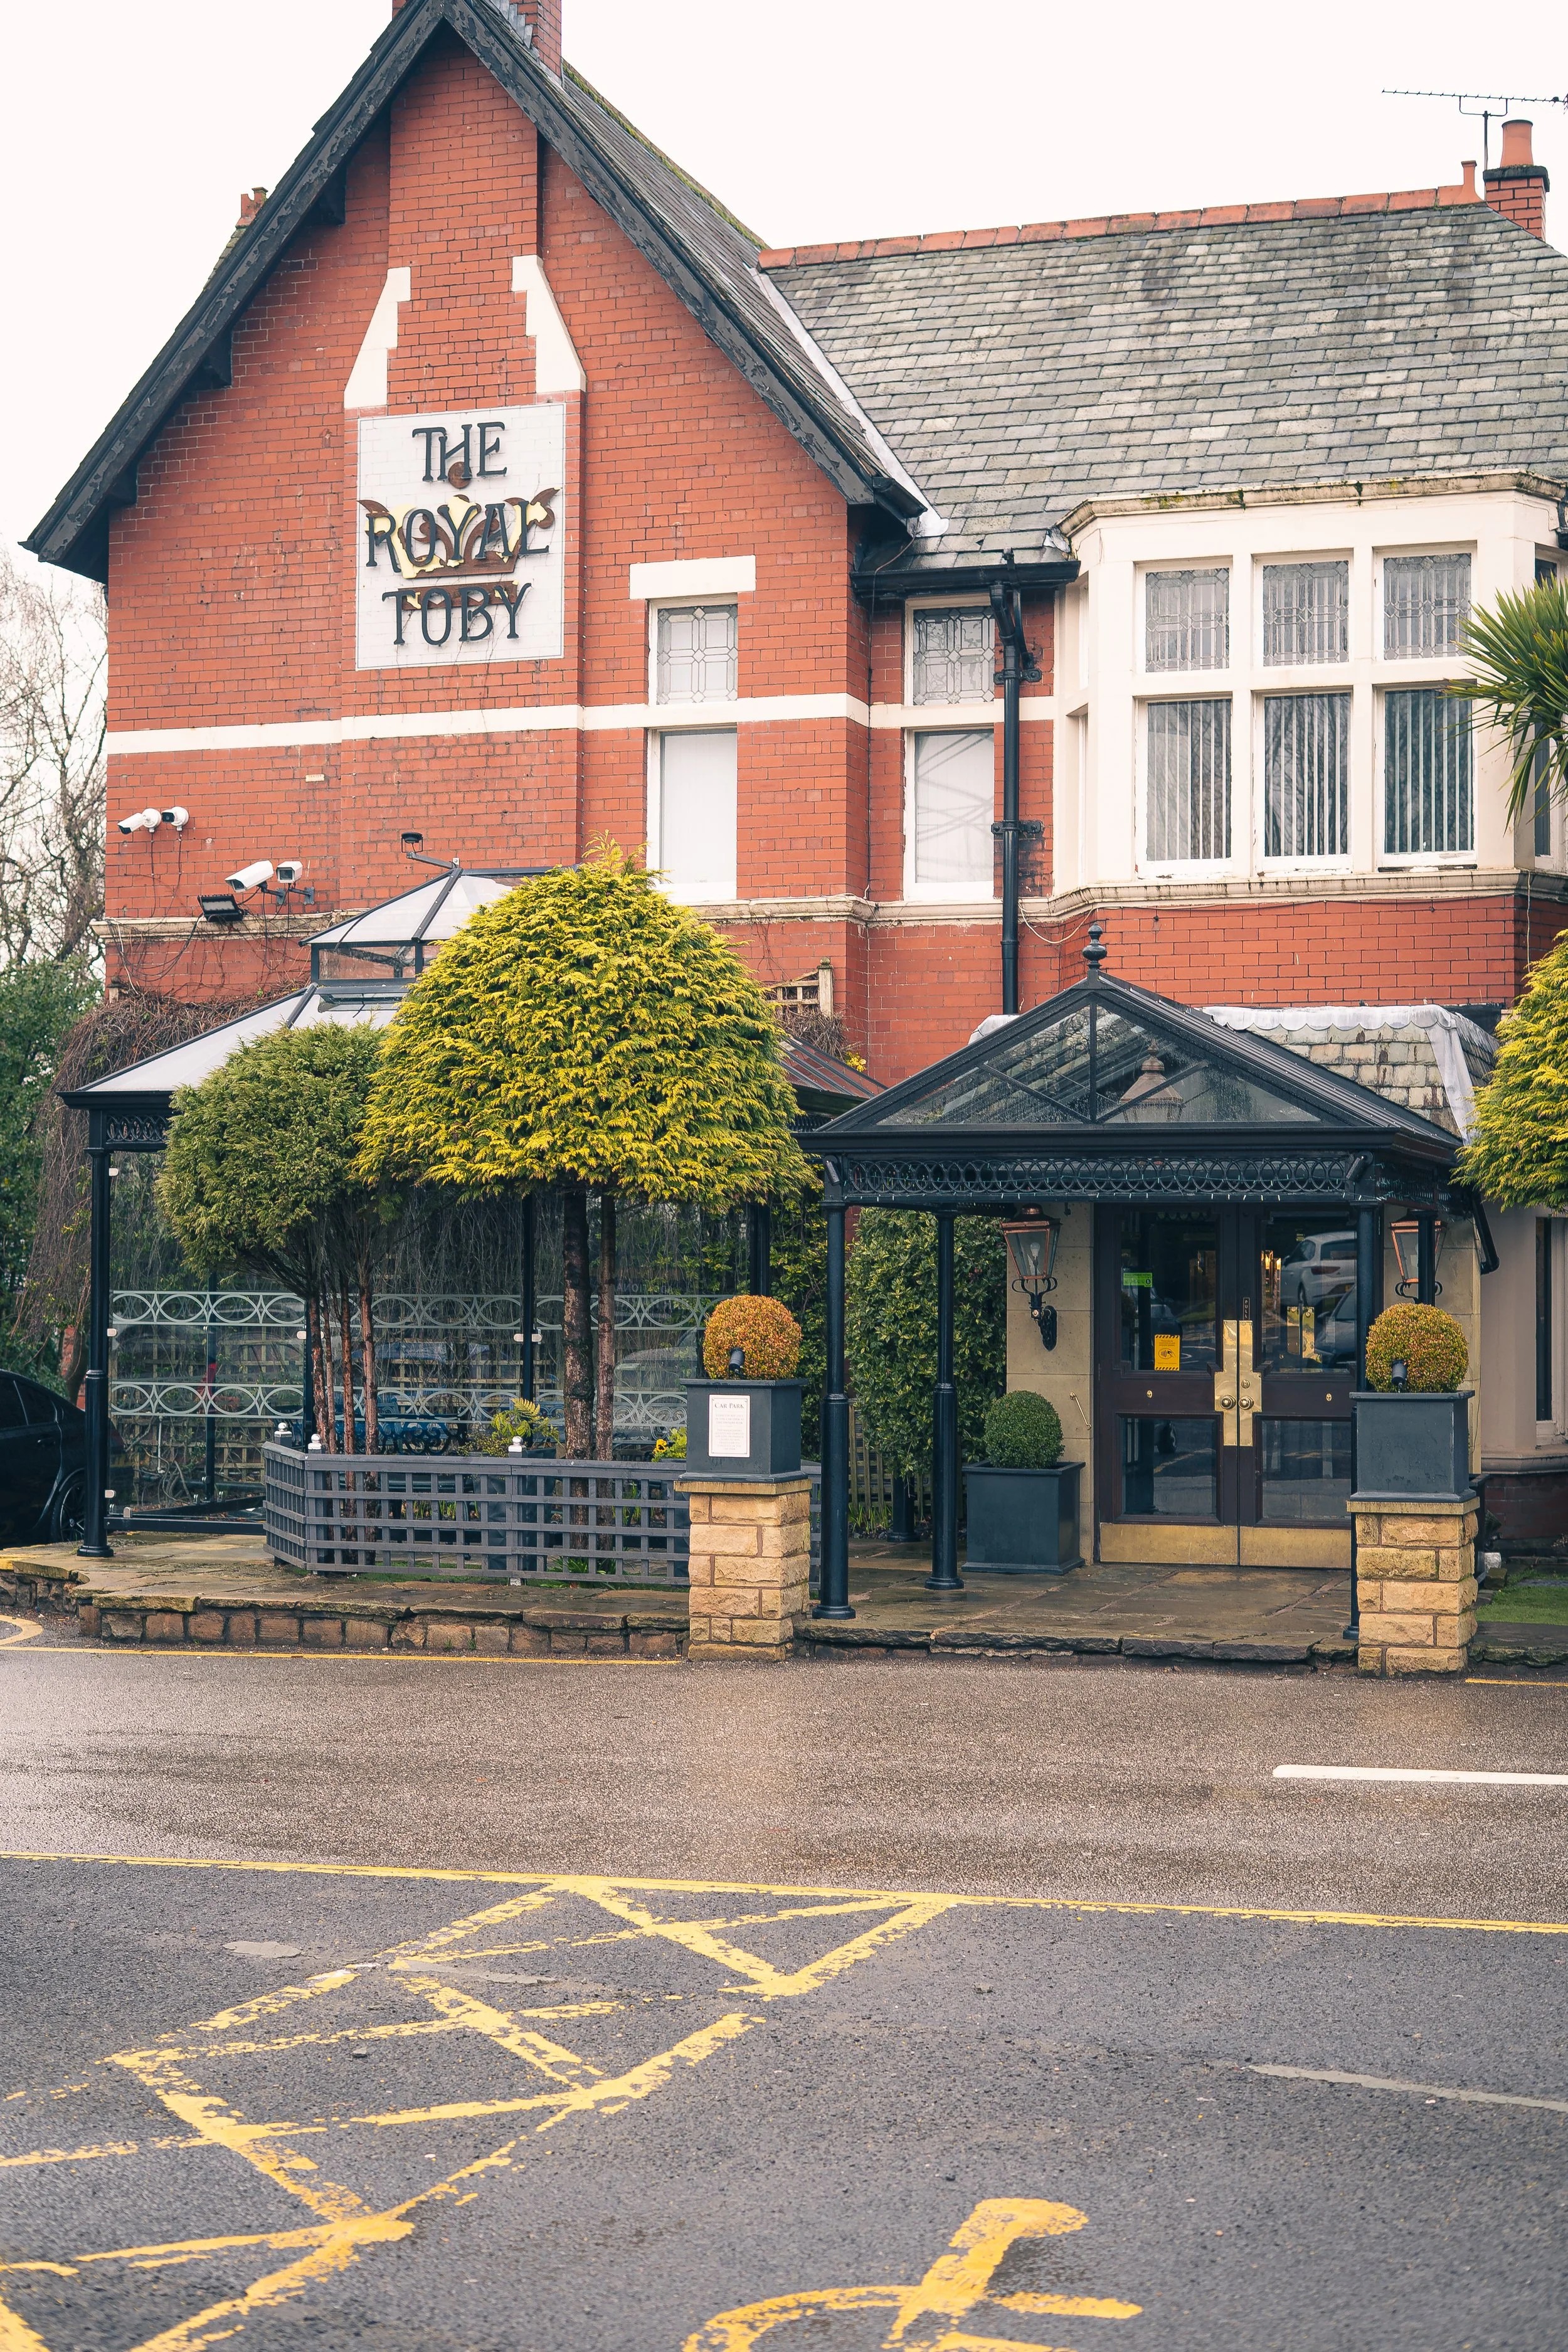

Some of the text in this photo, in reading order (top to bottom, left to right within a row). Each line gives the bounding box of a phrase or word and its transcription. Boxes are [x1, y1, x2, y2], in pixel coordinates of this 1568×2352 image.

[411, 421, 508, 482] THE
[366, 501, 549, 573] ROYAL
[381, 582, 532, 647] TOBY
